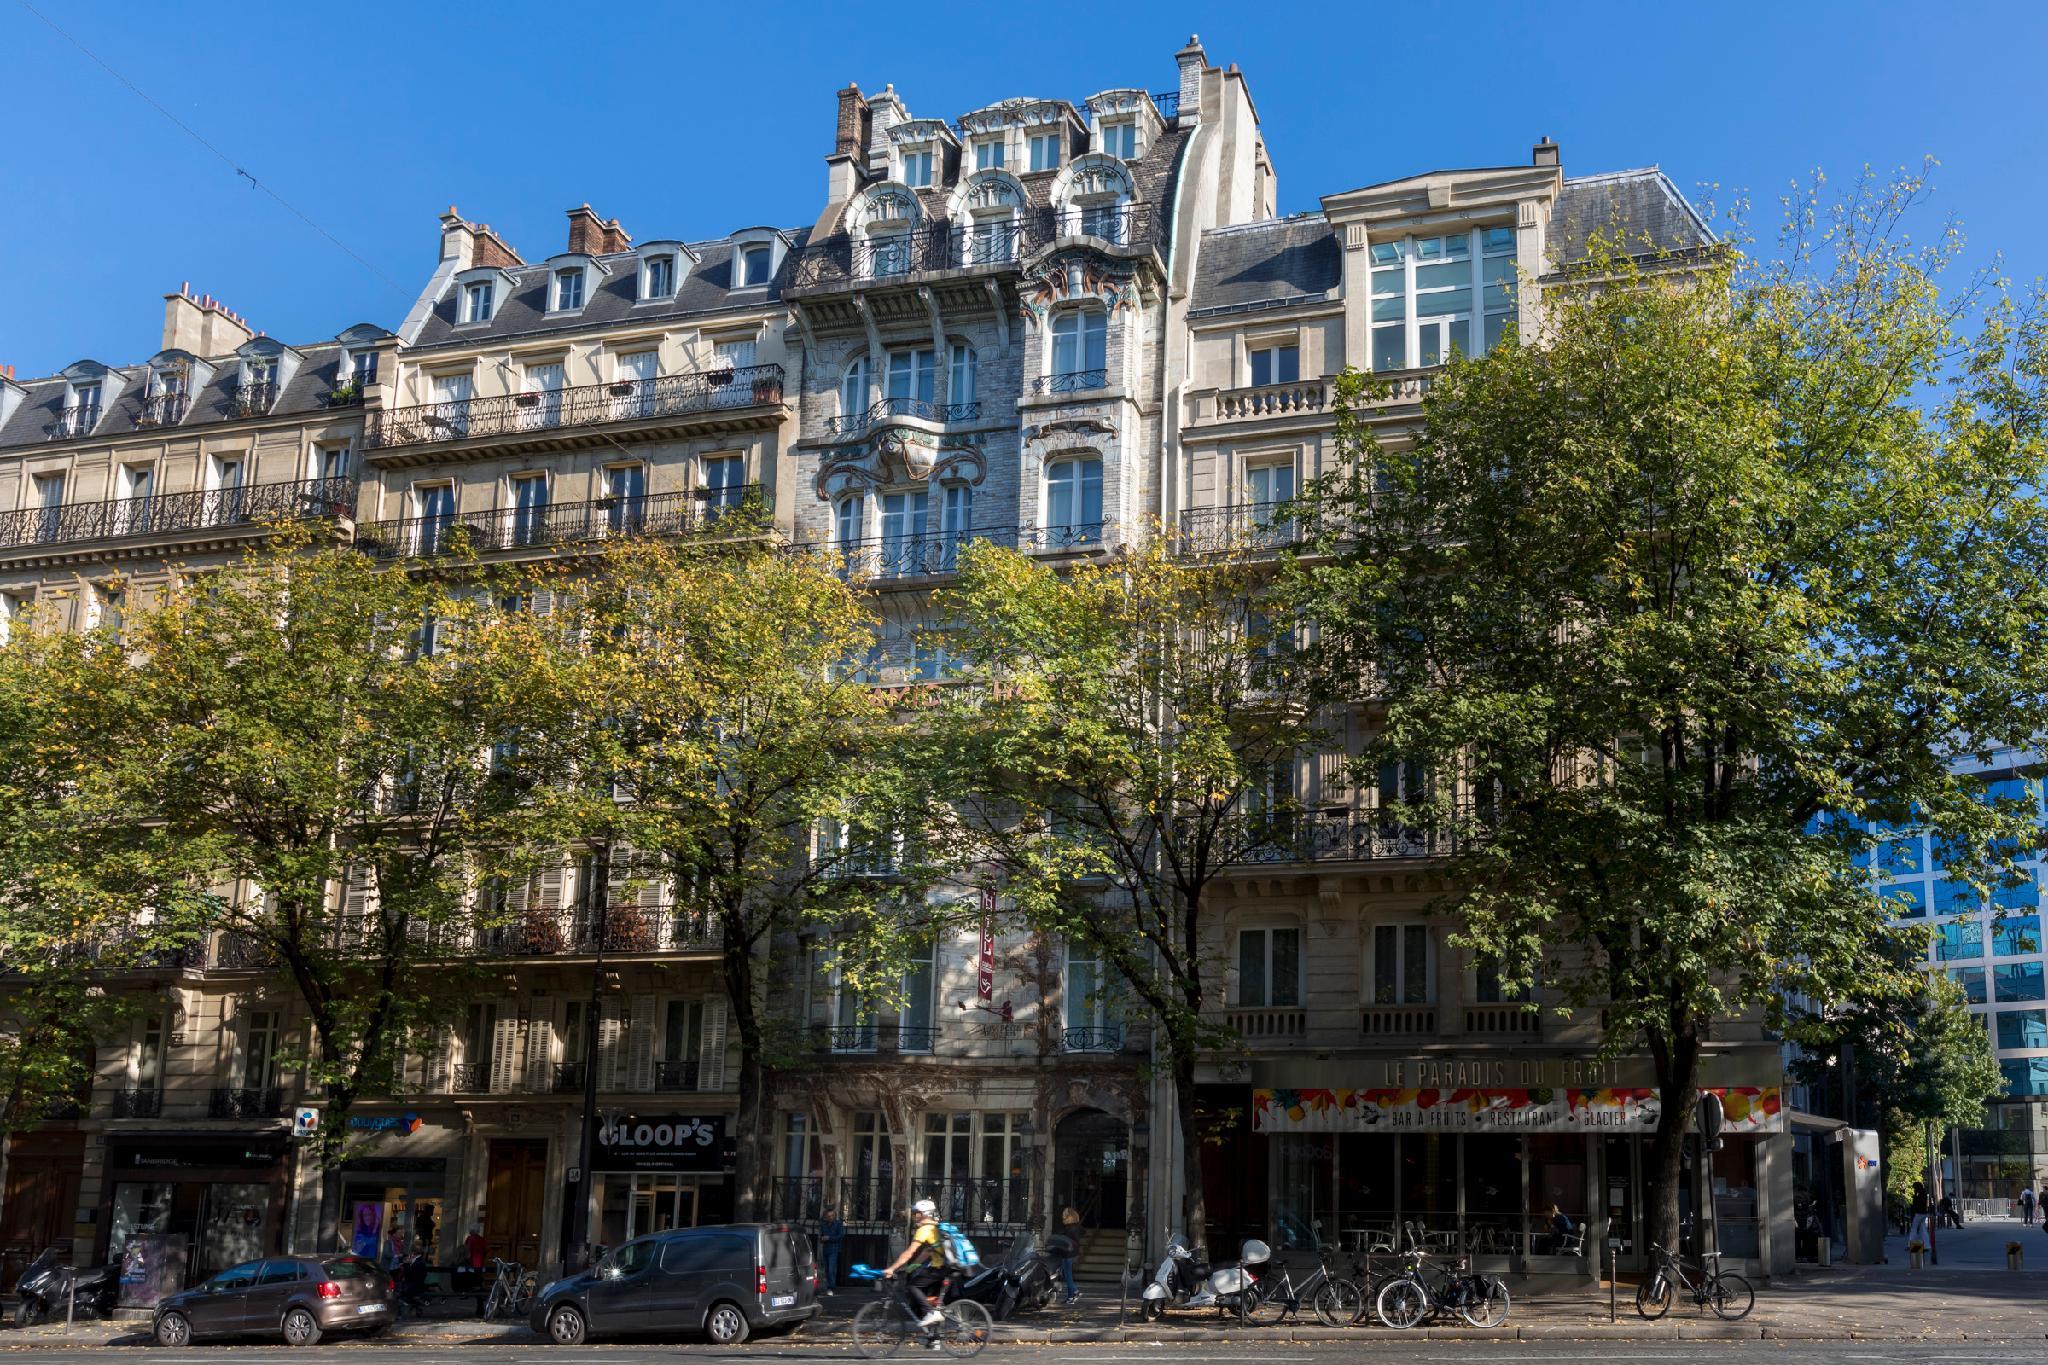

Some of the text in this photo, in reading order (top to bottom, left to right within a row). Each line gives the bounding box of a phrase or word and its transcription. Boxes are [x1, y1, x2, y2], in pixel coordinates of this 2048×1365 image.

[1384, 1059, 1622, 1086] LE PARADIS DU FRUIT
[1392, 1111, 1412, 1126] BAR
[1430, 1111, 1467, 1126] FRUITS
[1490, 1110, 1558, 1126] RESTAURANT
[1585, 1110, 1626, 1126] GLACIER
[598, 1118, 714, 1146] GLOOP'S
